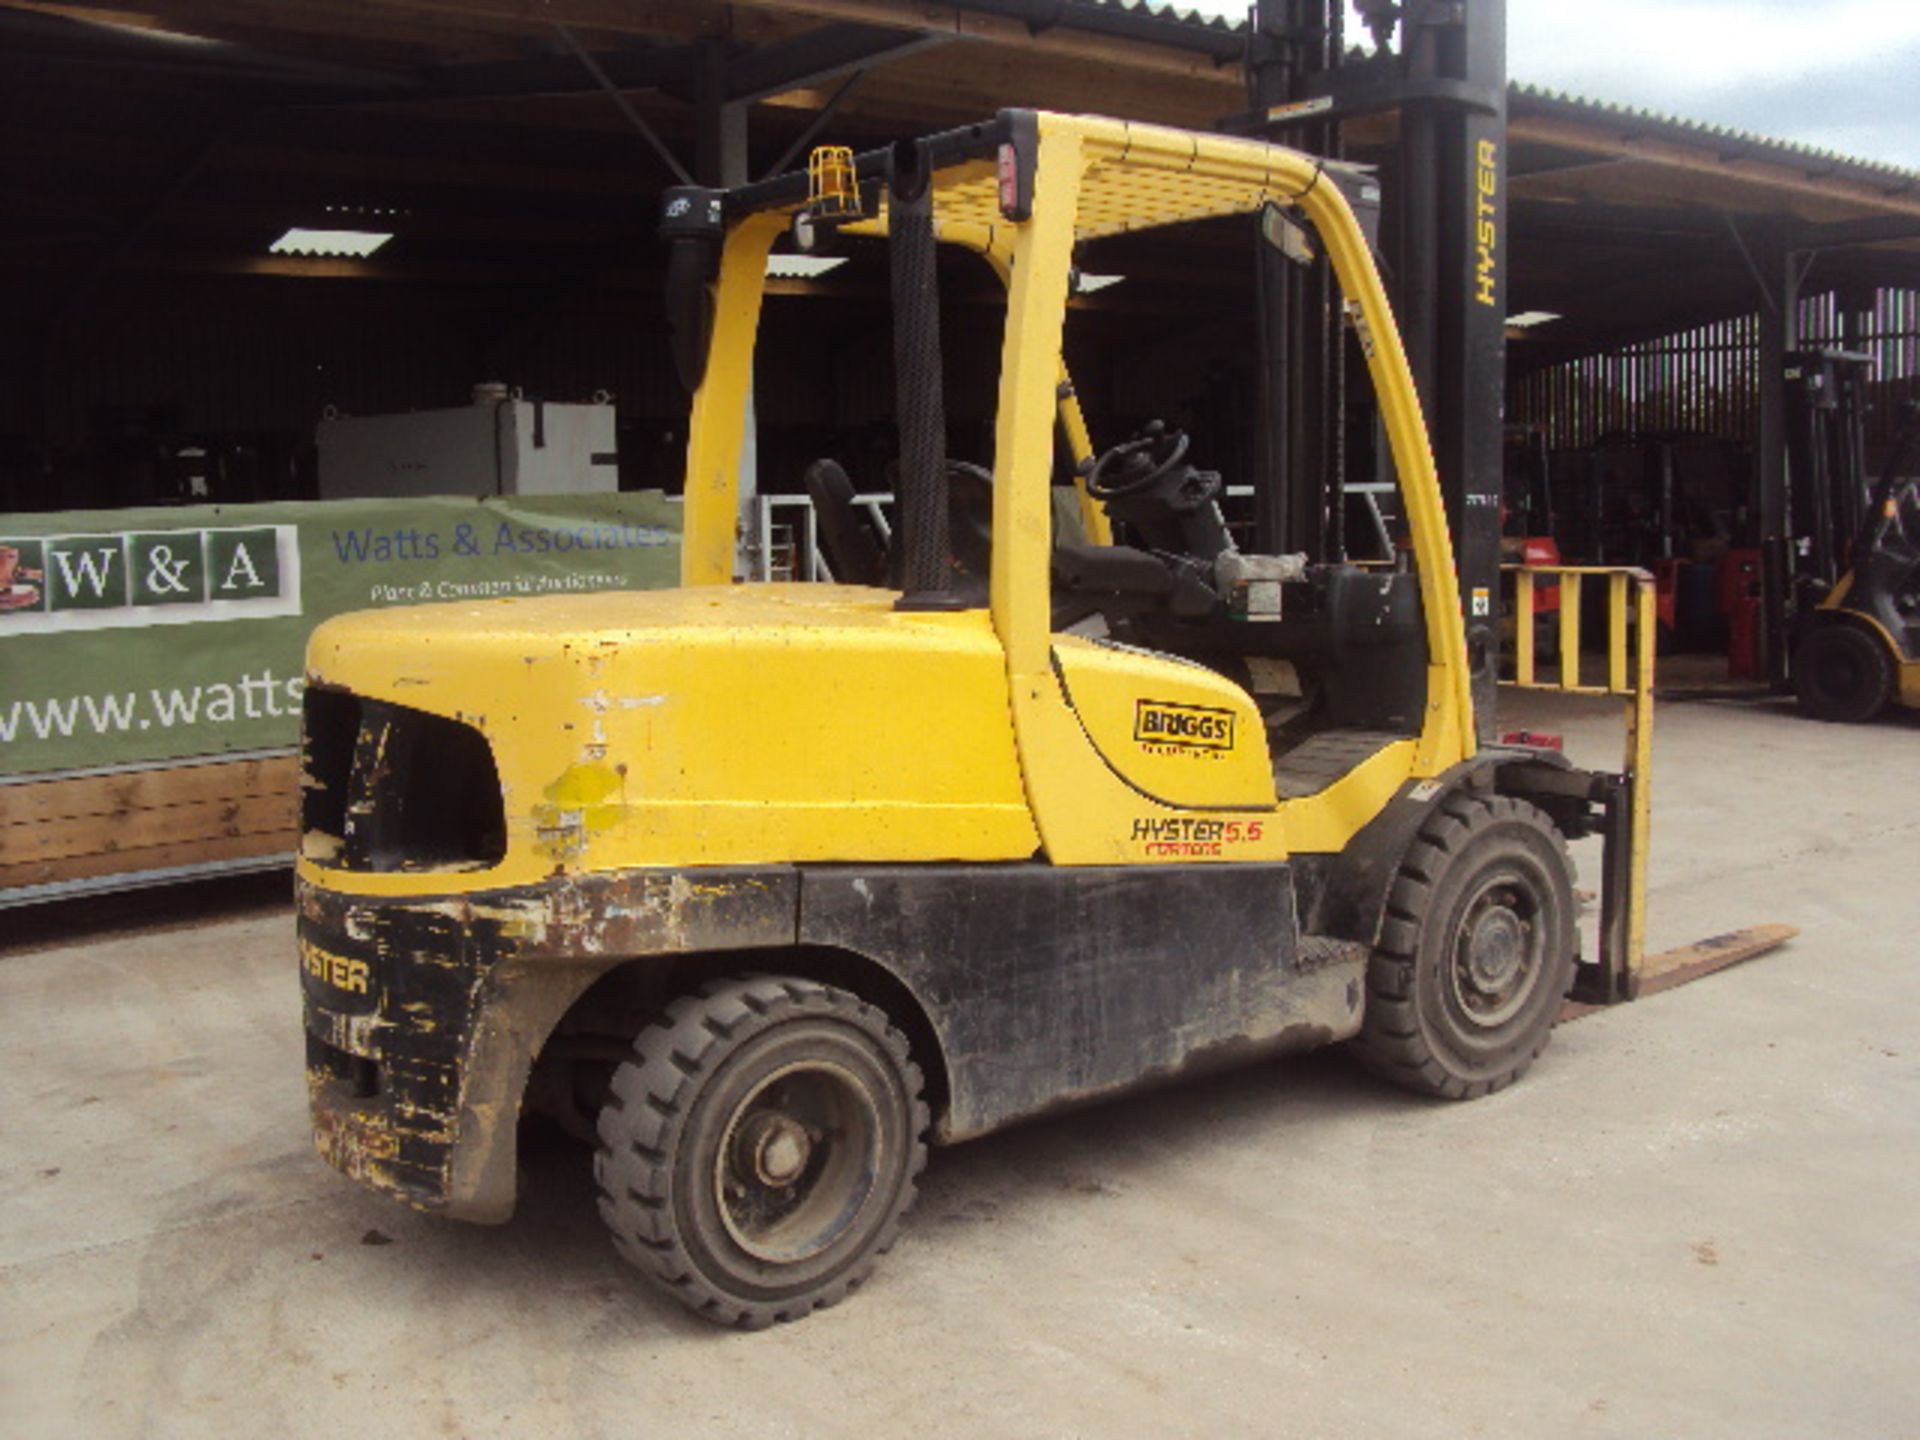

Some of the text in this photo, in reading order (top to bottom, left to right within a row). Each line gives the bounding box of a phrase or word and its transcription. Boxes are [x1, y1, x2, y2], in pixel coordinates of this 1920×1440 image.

[1476, 138, 1496, 307] HYSTER
[333, 521, 668, 564] Watts & Associates
[52, 542, 264, 598] W & A
[1142, 711, 1227, 739] BRIGGS
[1130, 817, 1224, 841] HYSTER
